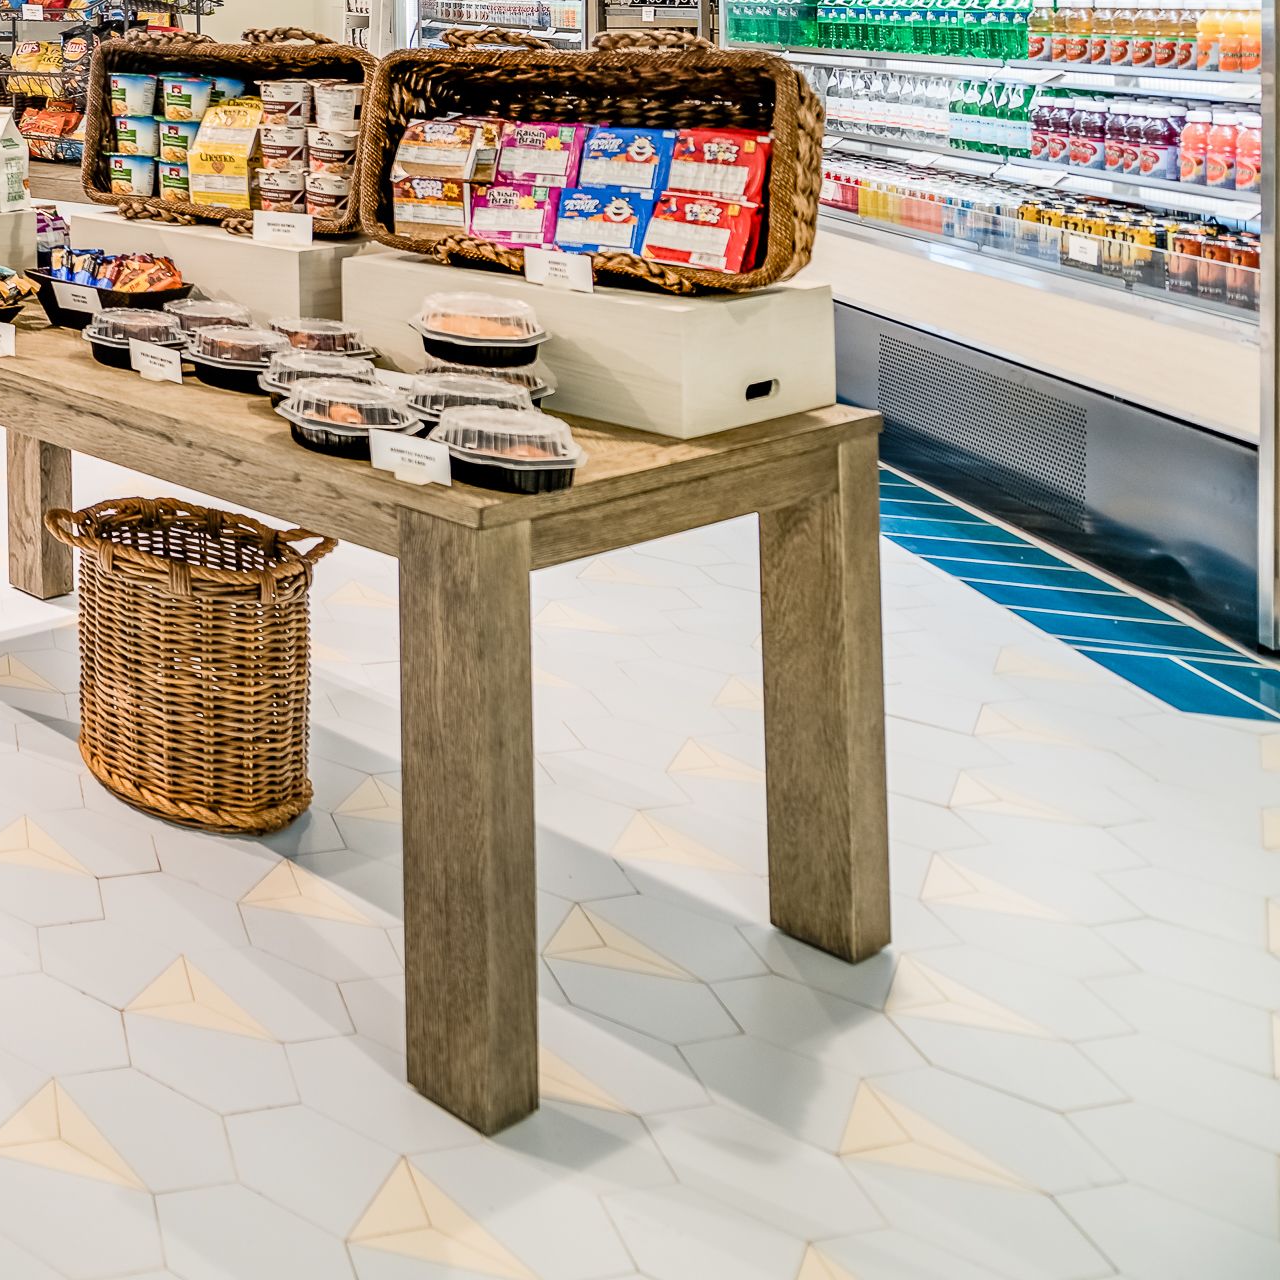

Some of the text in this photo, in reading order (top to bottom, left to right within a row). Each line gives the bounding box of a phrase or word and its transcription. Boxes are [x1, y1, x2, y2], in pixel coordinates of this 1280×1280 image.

[516, 129, 545, 138] Raisin
[518, 137, 542, 145] Bran
[199, 152, 236, 163] Cheerios
[488, 190, 518, 198] Raisin
[491, 197, 514, 205] Bran
